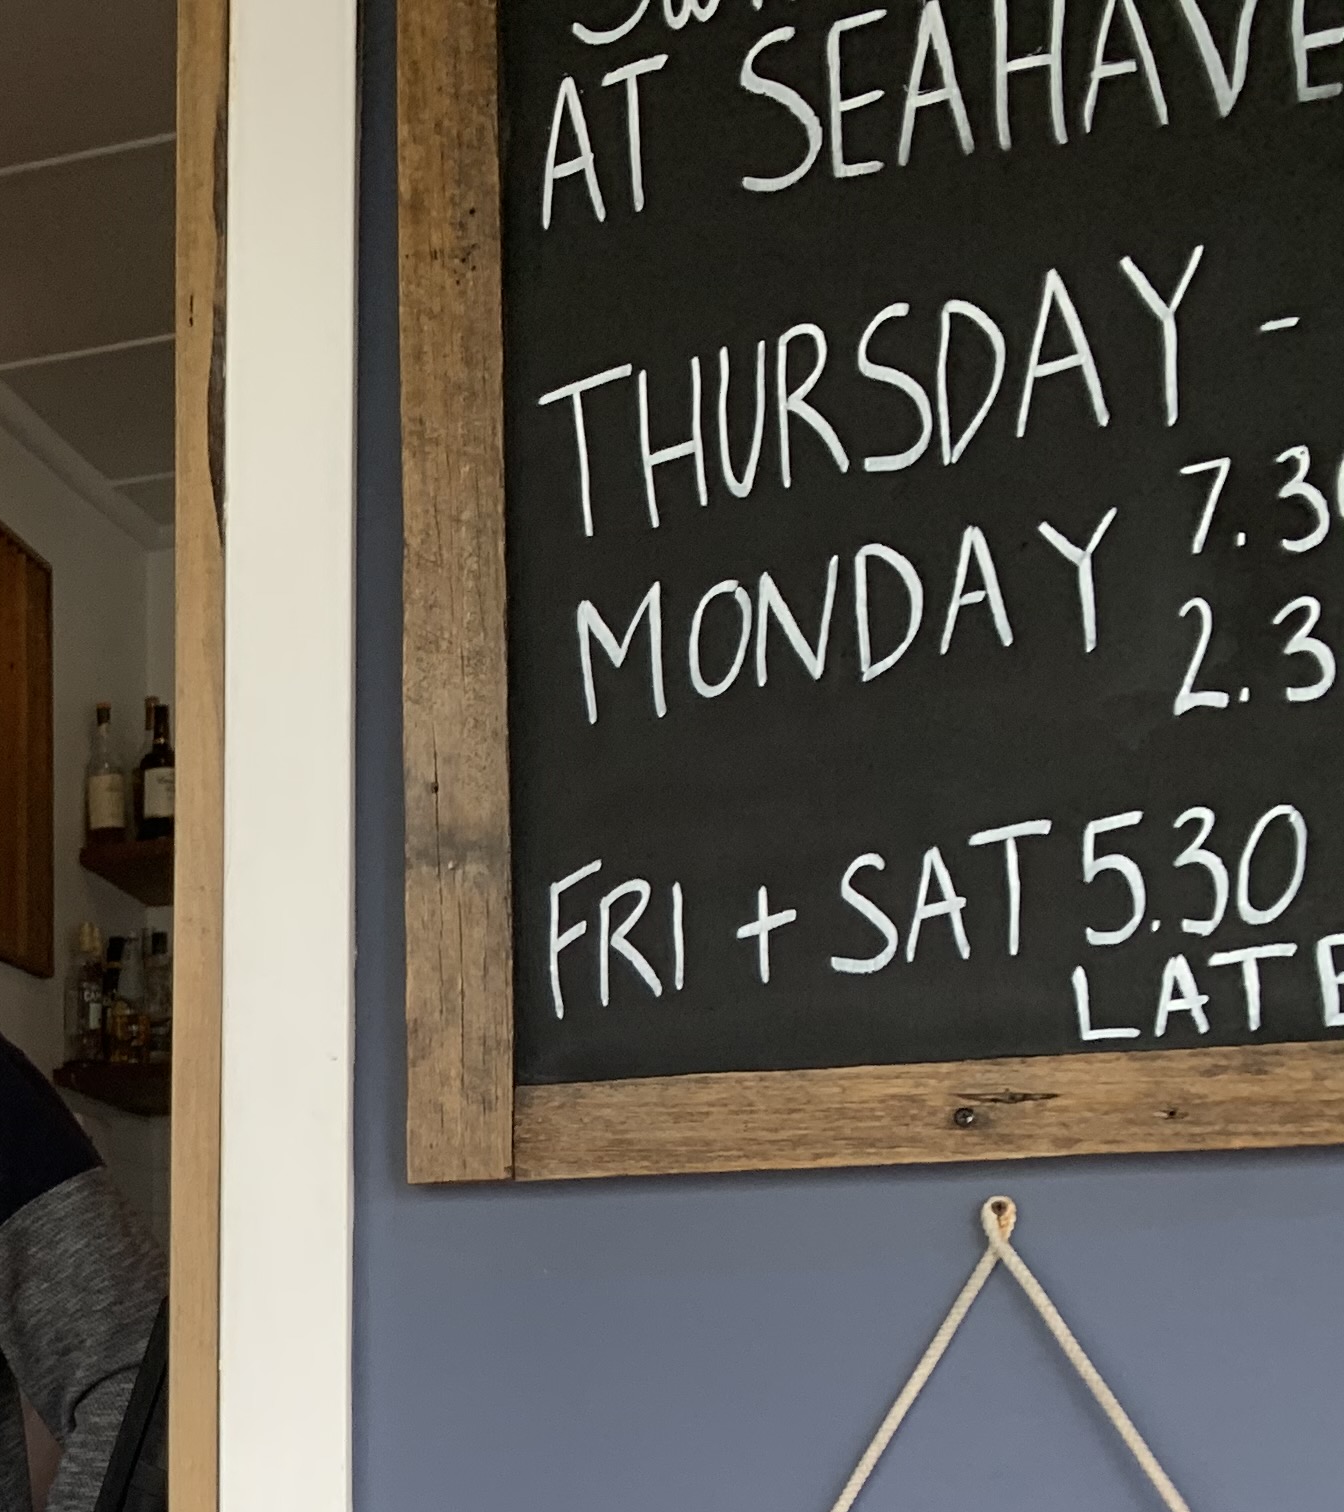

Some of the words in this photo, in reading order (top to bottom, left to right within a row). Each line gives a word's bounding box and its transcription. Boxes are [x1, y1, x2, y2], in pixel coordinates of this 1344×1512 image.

[543, 54, 668, 230] AT
[538, 245, 1205, 537] THURSDAY
[1179, 445, 1344, 554] 7.3
[576, 507, 1118, 725] MONDAY
[550, 860, 685, 1020] FRI
[737, 886, 797, 984] +
[831, 819, 1053, 975] SAT
[1082, 805, 1308, 946] 5.30
[1071, 933, 1344, 1041] LATE
